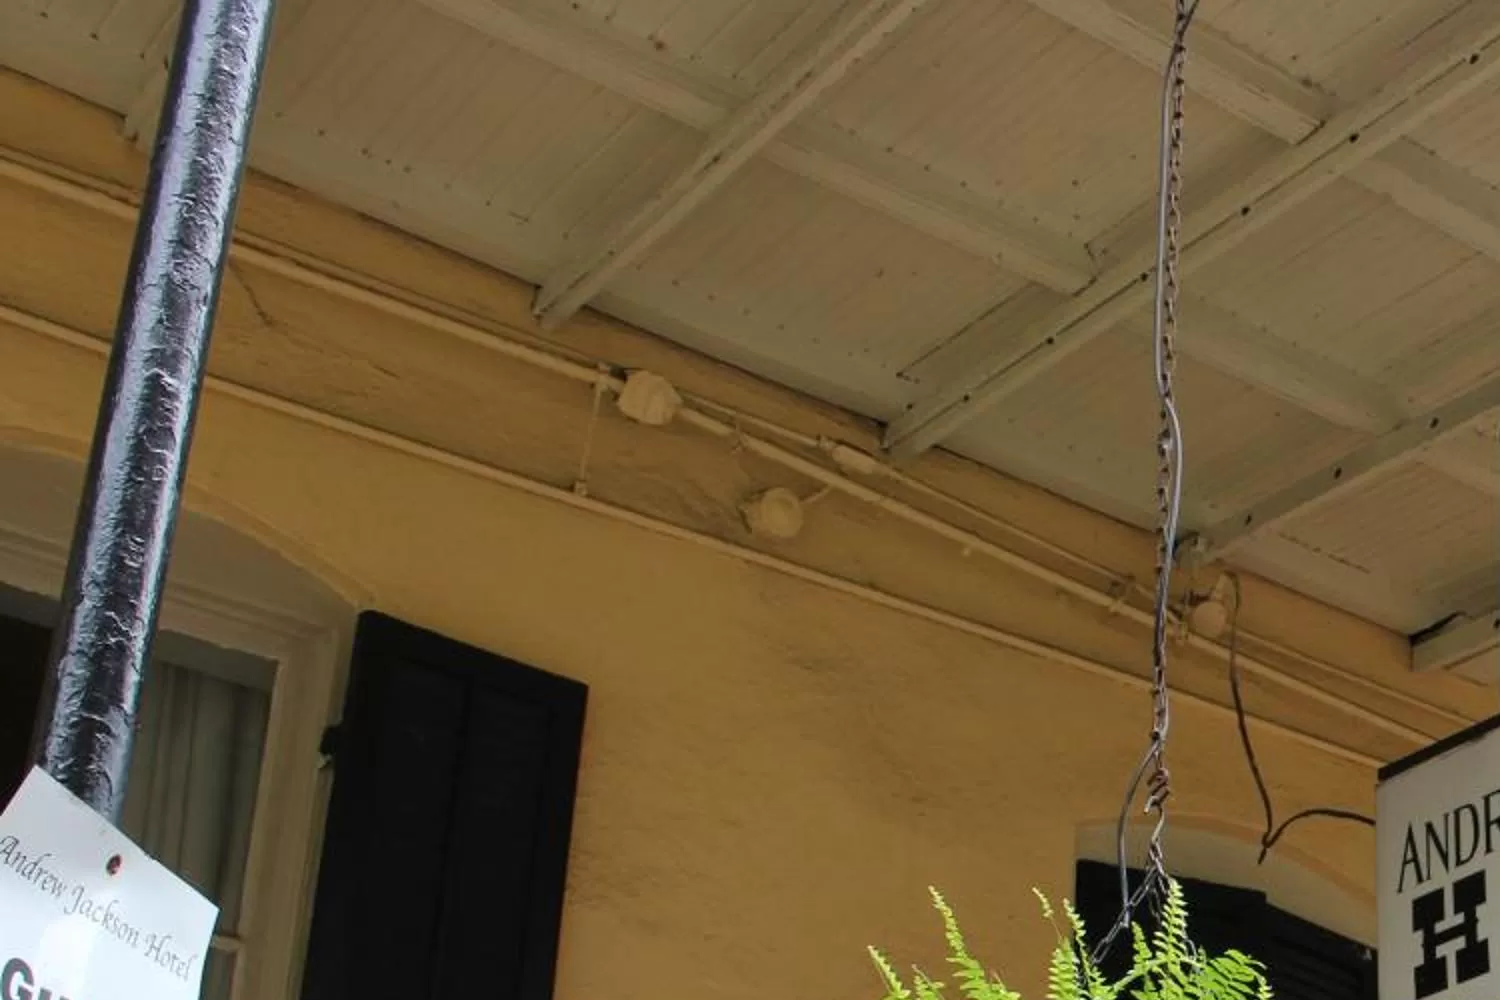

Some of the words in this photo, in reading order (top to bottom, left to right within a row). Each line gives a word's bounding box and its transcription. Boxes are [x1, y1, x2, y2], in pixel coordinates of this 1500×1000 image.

[0, 835, 67, 899] Andrew
[63, 884, 142, 948] Jackson
[143, 933, 198, 982] Hotel
